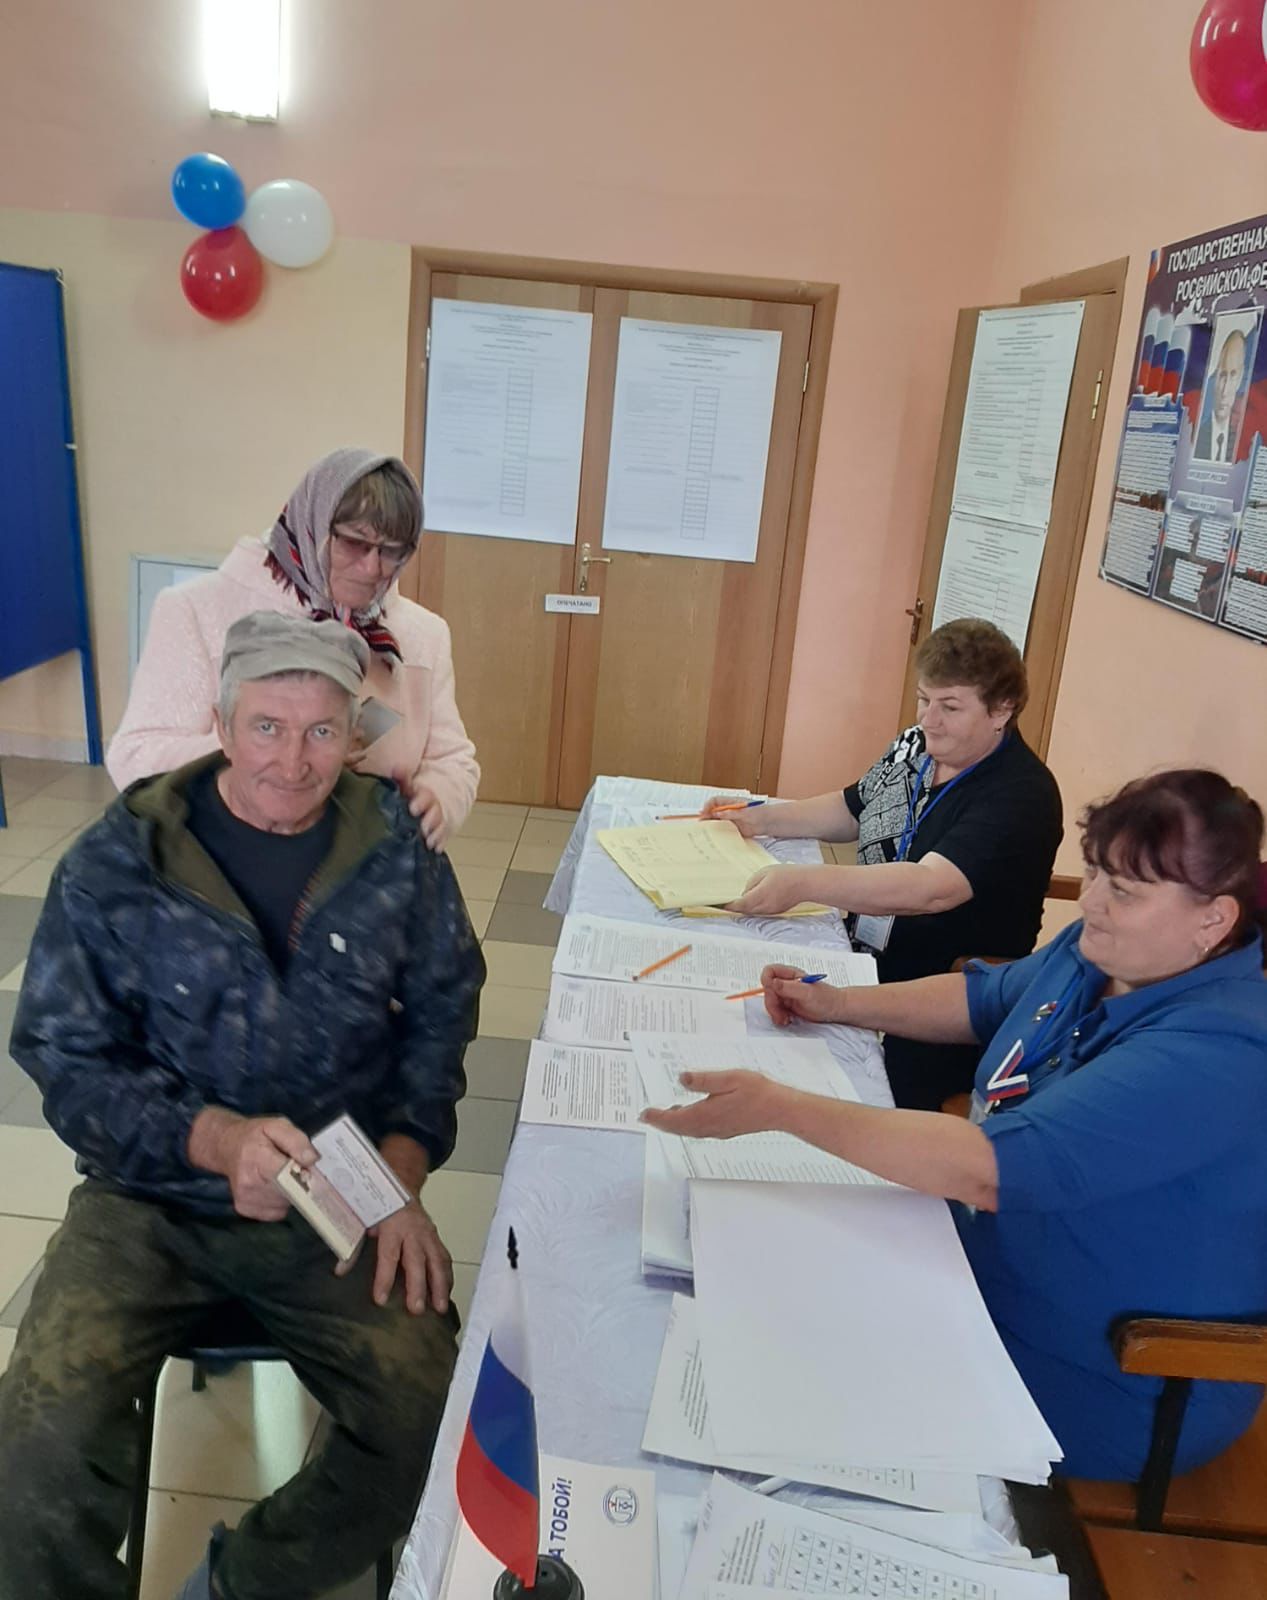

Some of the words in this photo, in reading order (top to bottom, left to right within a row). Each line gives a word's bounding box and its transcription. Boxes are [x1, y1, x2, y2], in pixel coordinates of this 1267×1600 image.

[1175, 260, 1249, 302] РОССИЙСКОЙ
[1250, 261, 1267, 289] ФЕ
[550, 1476, 573, 1541] ТОБОЙ!
